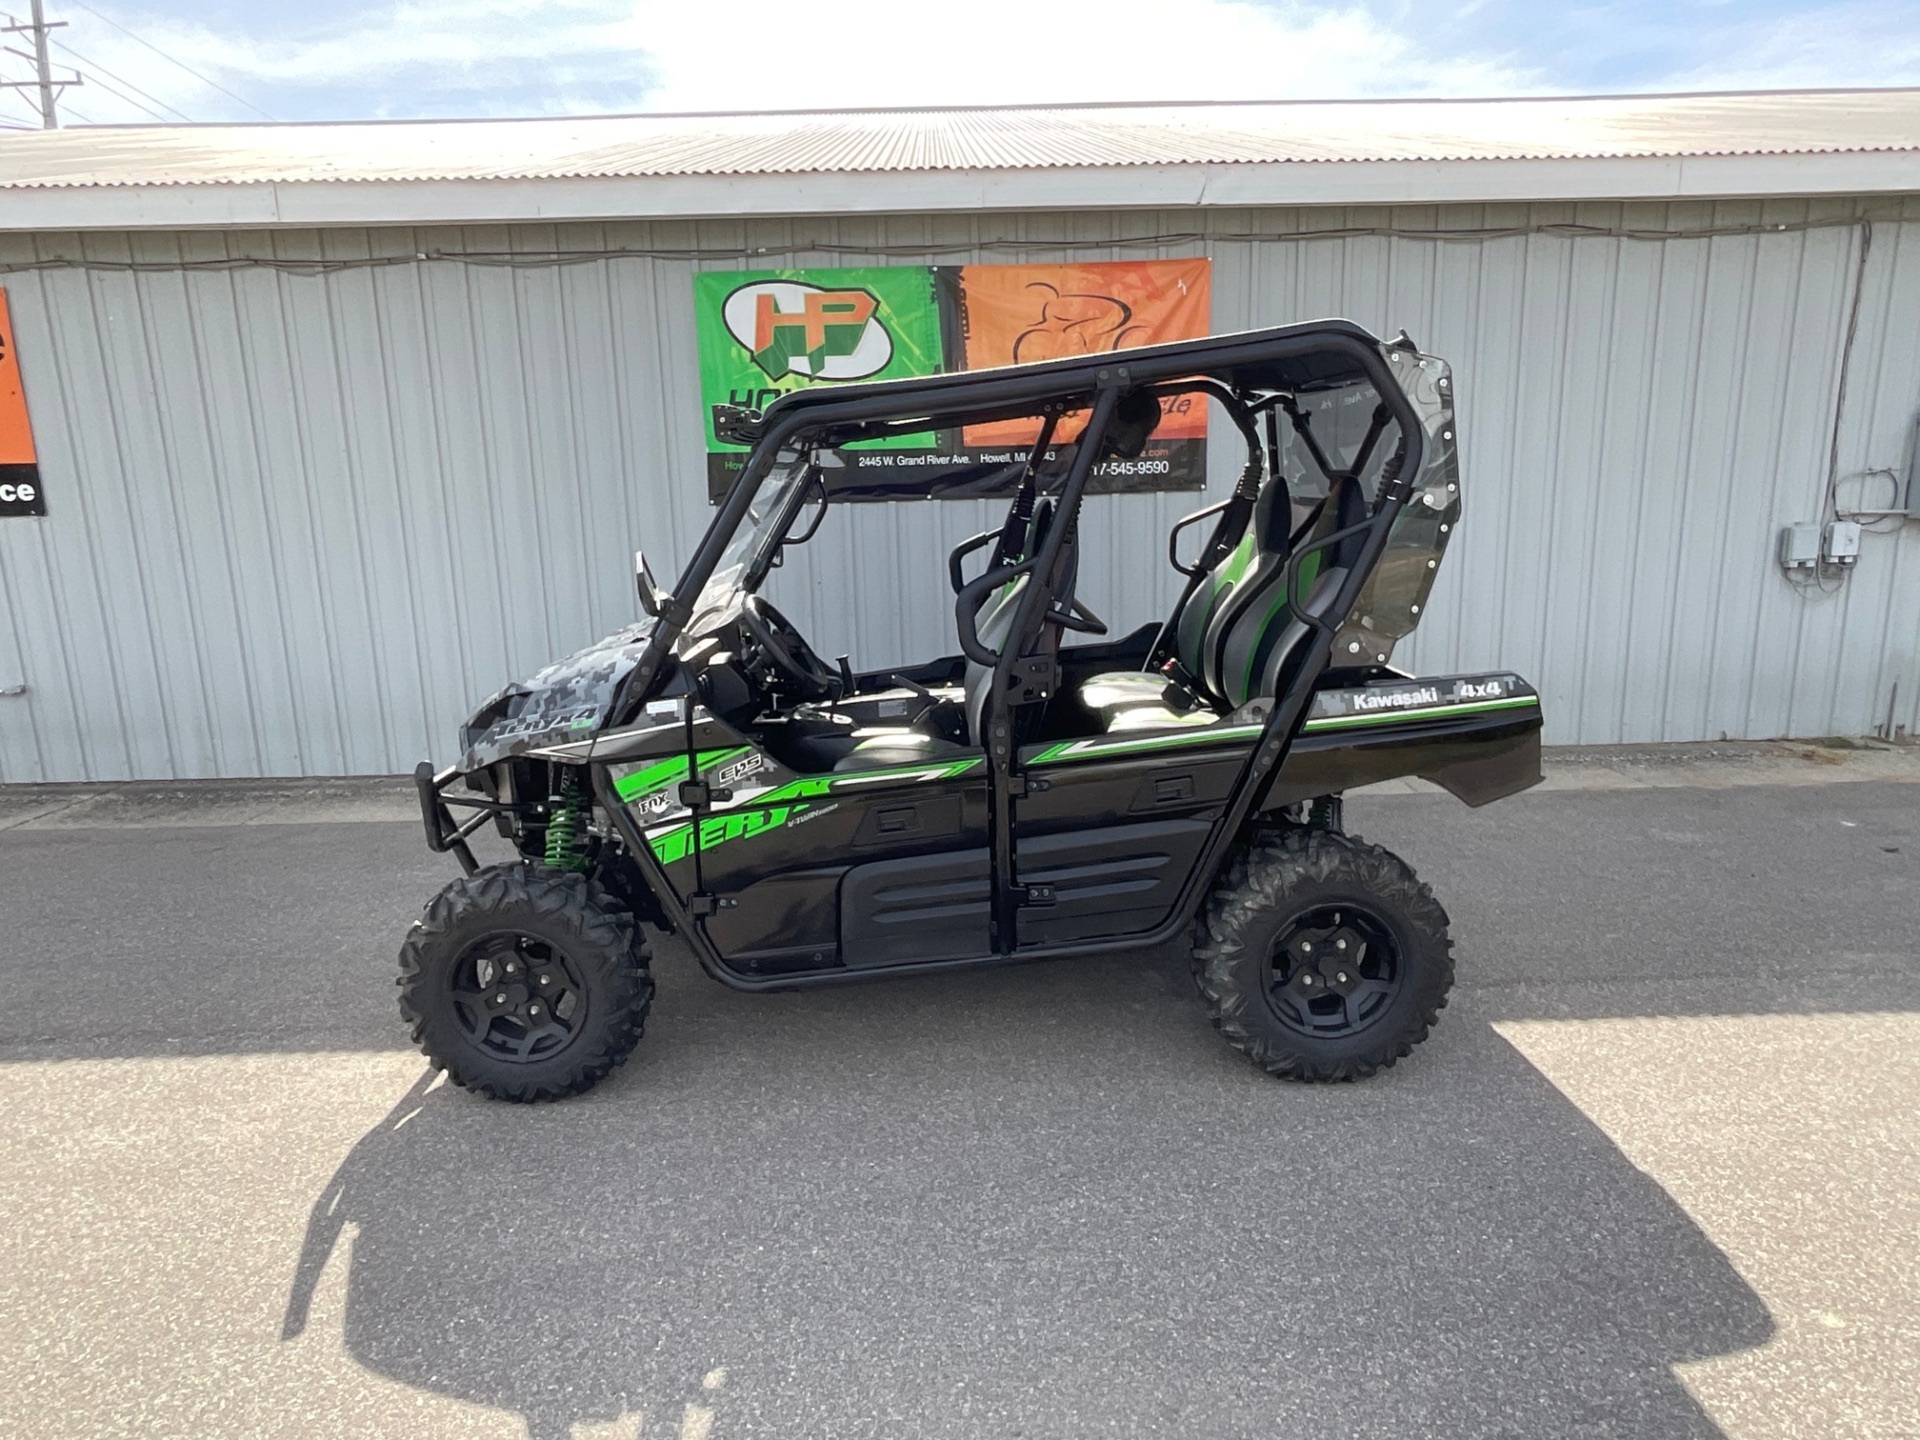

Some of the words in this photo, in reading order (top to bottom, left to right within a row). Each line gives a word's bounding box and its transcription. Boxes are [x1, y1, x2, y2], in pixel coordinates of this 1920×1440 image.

[754, 291, 877, 366] HP
[729, 388, 791, 411] HO
[859, 456, 881, 467] 2445
[897, 455, 925, 466] Grand
[927, 455, 949, 465] River
[952, 454, 971, 464] Ave.
[980, 453, 1012, 463] Howell,
[1015, 452, 1026, 462] MI
[1092, 461, 1170, 476] 17-545-9590
[1353, 687, 1438, 711] Kawasaki
[1460, 681, 1502, 698] 4x4
[719, 753, 762, 784] EPS
[639, 791, 673, 815] FOX
